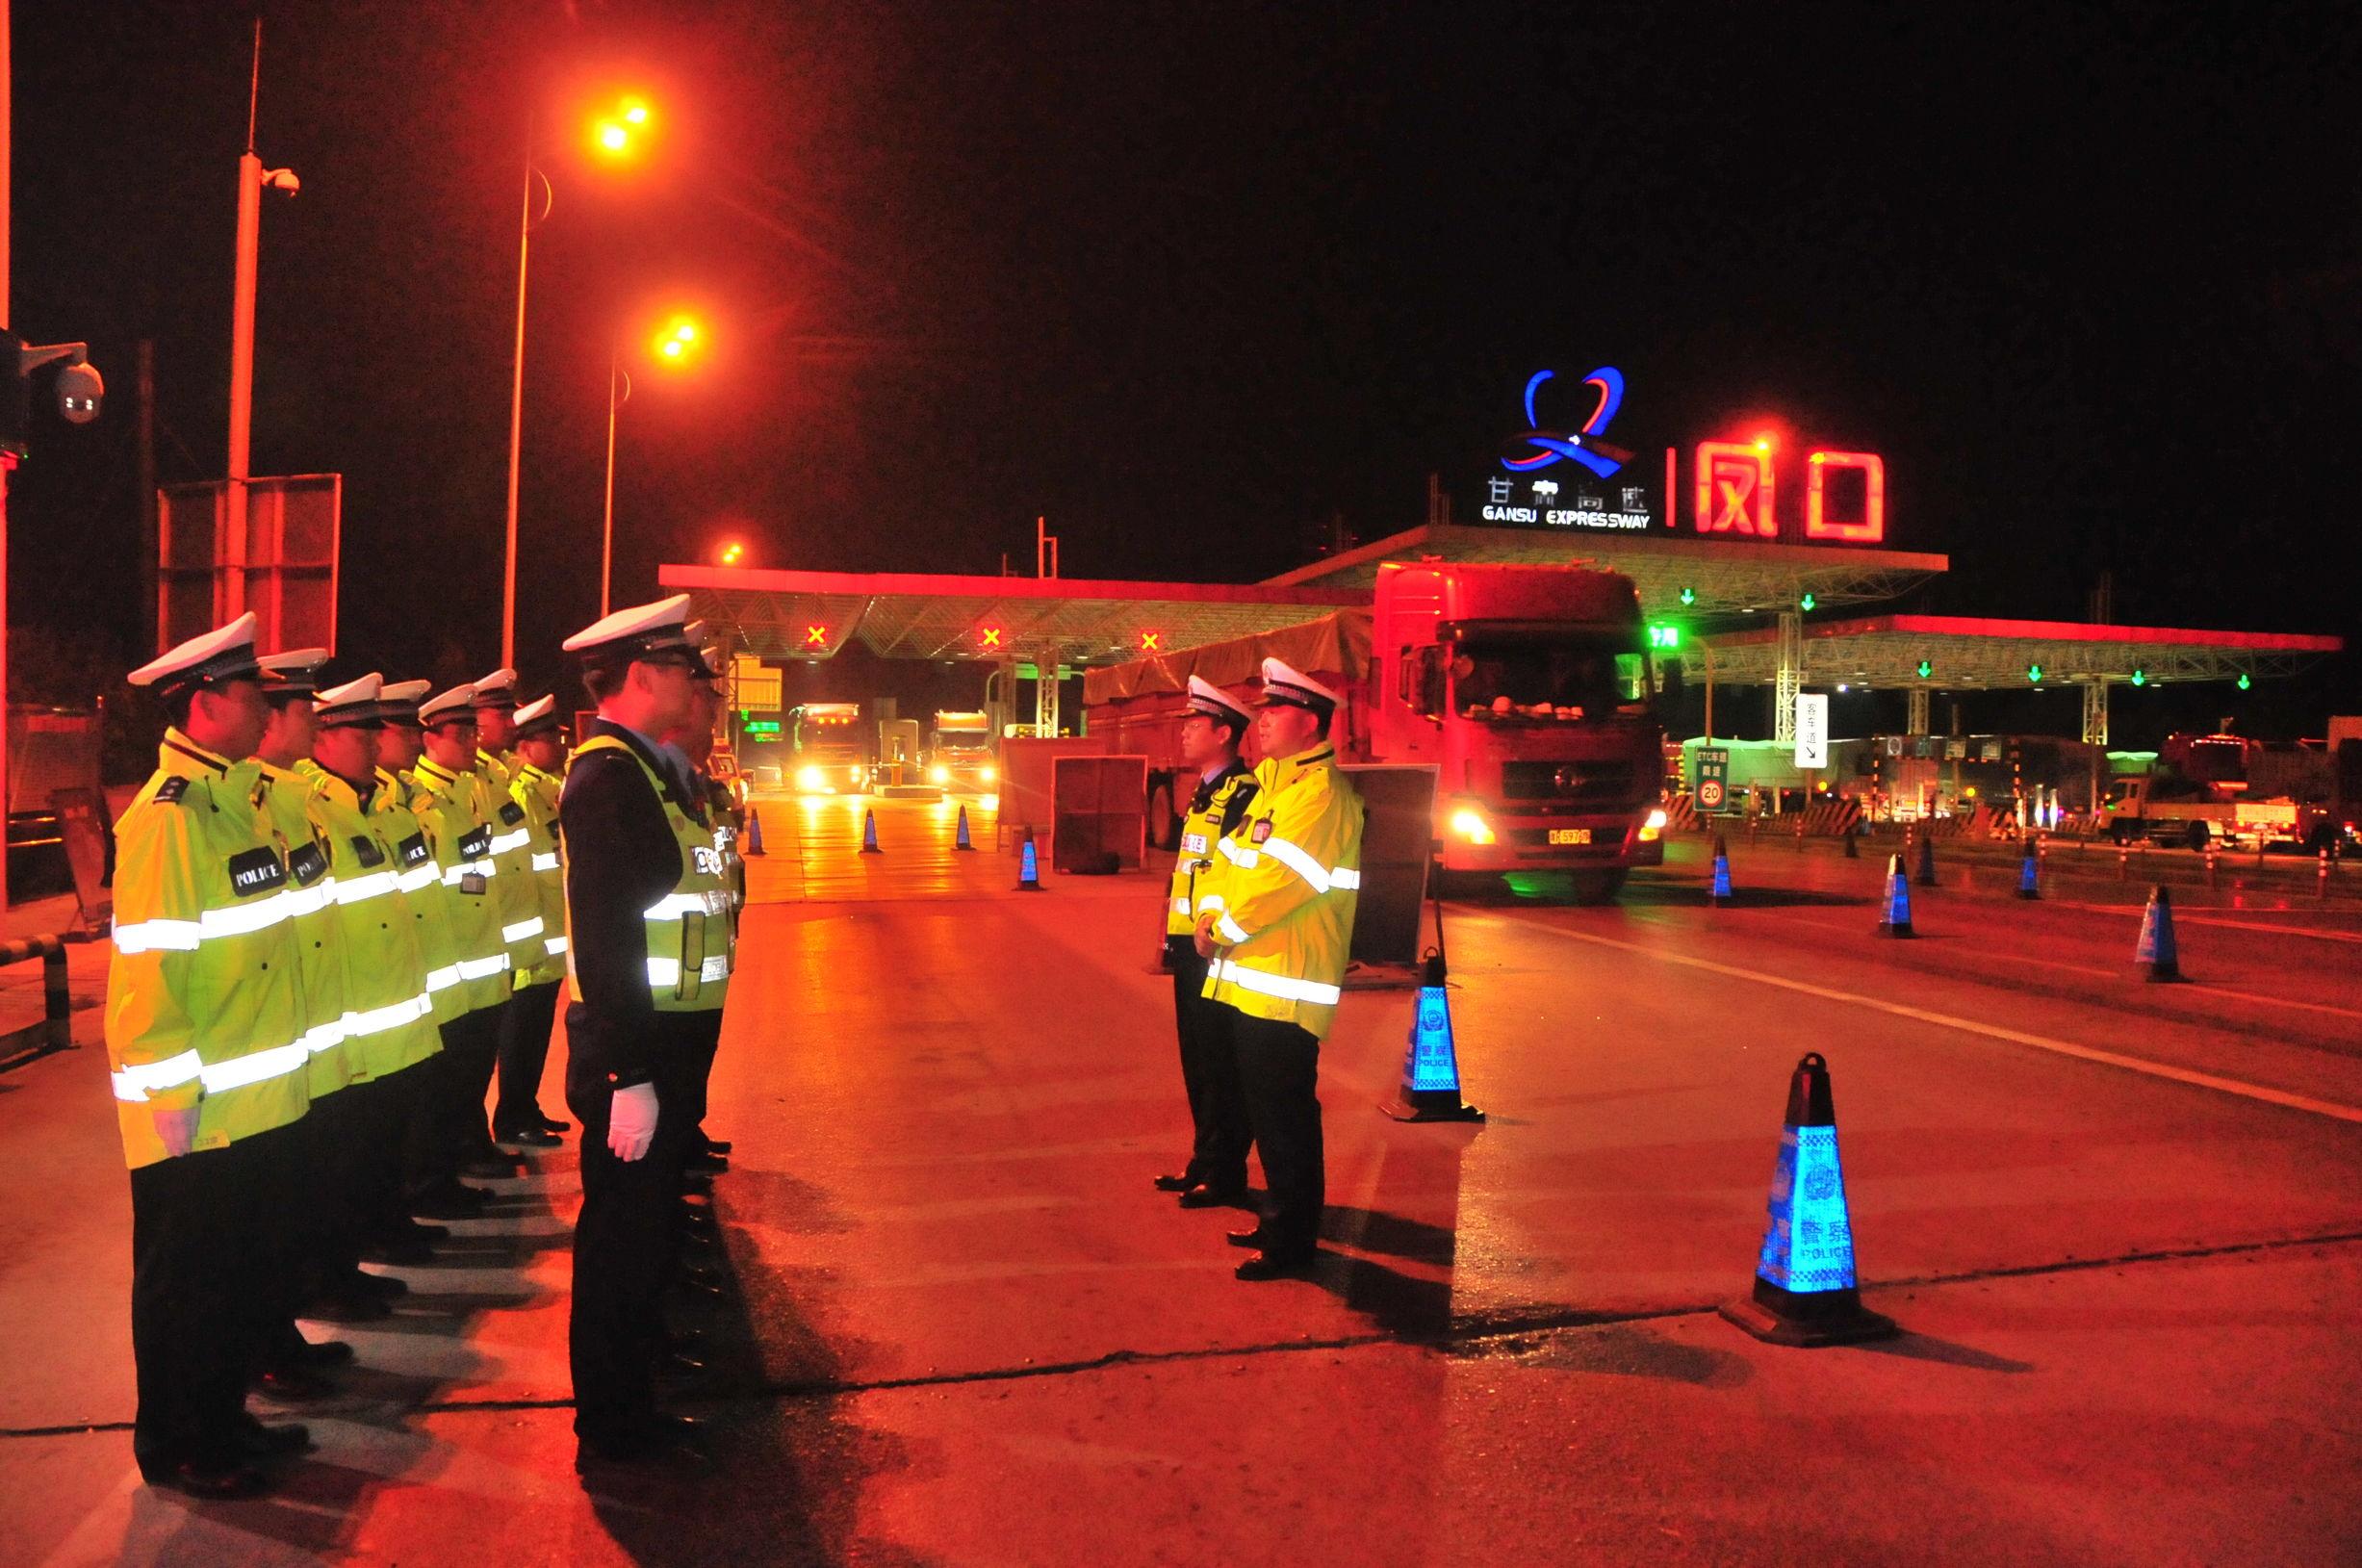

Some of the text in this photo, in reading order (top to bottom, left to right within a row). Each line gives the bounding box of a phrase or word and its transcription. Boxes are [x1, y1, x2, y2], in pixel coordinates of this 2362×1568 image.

[1482, 505, 1650, 528] GANSU EXPRESSWAY
[1705, 787, 1719, 799] 20
[236, 863, 279, 887] POLICE
[1802, 1246, 1852, 1260] POLICE
